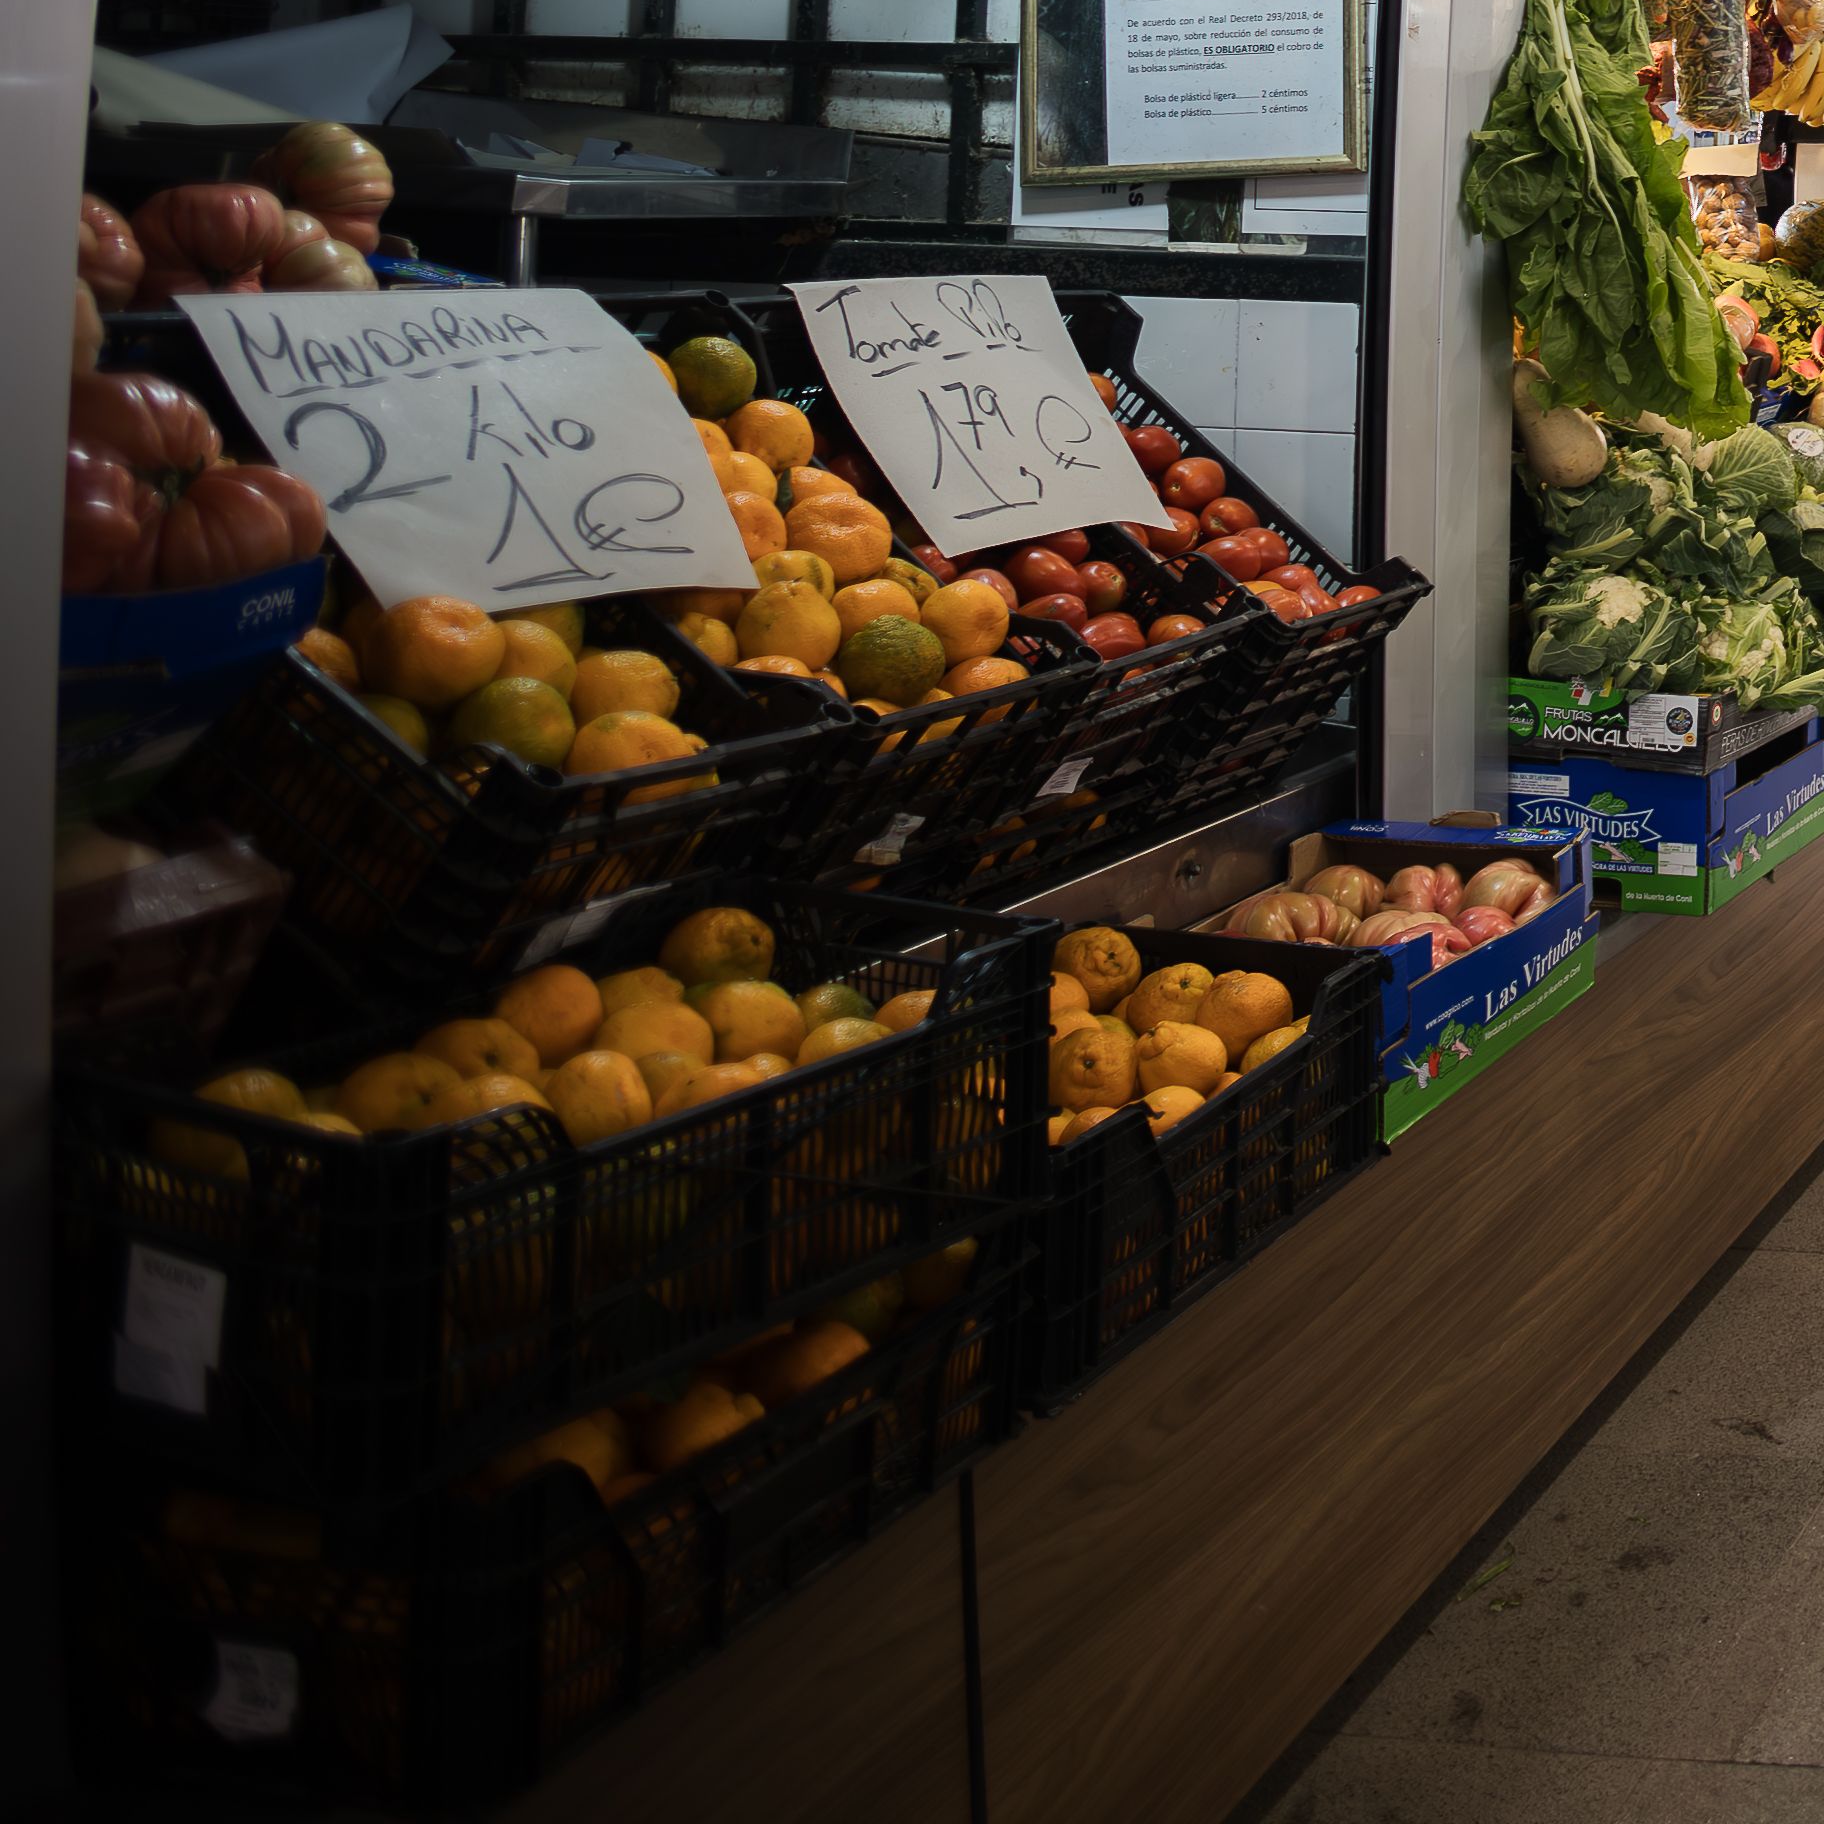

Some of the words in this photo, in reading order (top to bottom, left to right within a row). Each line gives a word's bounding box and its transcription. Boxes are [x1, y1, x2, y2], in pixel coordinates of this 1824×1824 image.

[1127, 19, 1139, 28] De
[1142, 18, 1176, 27] acuerdo
[1179, 18, 1195, 26] con
[1197, 16, 1206, 25] el
[1208, 16, 1227, 24] Real
[1230, 14, 1263, 24] Decreto
[1266, 11, 1310, 22] 293/2018,
[1312, 11, 1324, 20] de
[1127, 34, 1138, 43] 18
[1141, 33, 1152, 42] de
[1155, 34, 1181, 43] mayo,
[1184, 32, 1207, 41] sobre
[1210, 29, 1251, 39] reducción
[1254, 28, 1268, 37] del
[1271, 28, 1310, 37] consumo
[1312, 26, 1324, 35] de
[1127, 49, 1154, 58] bolsas
[1155, 48, 1166, 57] de
[1203, 46, 1214, 55] ES
[1215, 44, 1275, 55] OBLIGATORIO
[1276, 43, 1285, 52] el
[1286, 42, 1311, 52] cobro
[1312, 41, 1324, 50] de
[1127, 64, 1139, 74] las
[1141, 63, 1167, 73] bolsas
[1169, 61, 1227, 72] suministradas.
[1144, 94, 1167, 104] Bolsa
[1168, 93, 1179, 103] de
[1180, 91, 1212, 104] plástico
[1261, 89, 1267, 98] 2
[1268, 88, 1308, 98] céntimos
[1144, 109, 1167, 119] Bolsa
[1168, 108, 1179, 118] de
[1261, 105, 1266, 114] 5
[1269, 104, 1308, 113] céntimos
[815, 284, 943, 364] Tomate
[284, 401, 453, 514] 2
[242, 586, 296, 618] CONIL
[1544, 706, 1593, 722] FRUTAS
[1765, 805, 1784, 837] Las
[1785, 773, 1824, 815] Virtudes
[1535, 806, 1561, 825] LAS
[1563, 808, 1640, 840] VIRTUDES
[1616, 864, 1627, 873] LAS
[1626, 864, 1653, 873] VIRTUDES
[1643, 892, 1664, 901] Huerta
[1665, 892, 1675, 901] de
[1484, 978, 1518, 1024] Las
[1522, 925, 1583, 988] Virtudes
